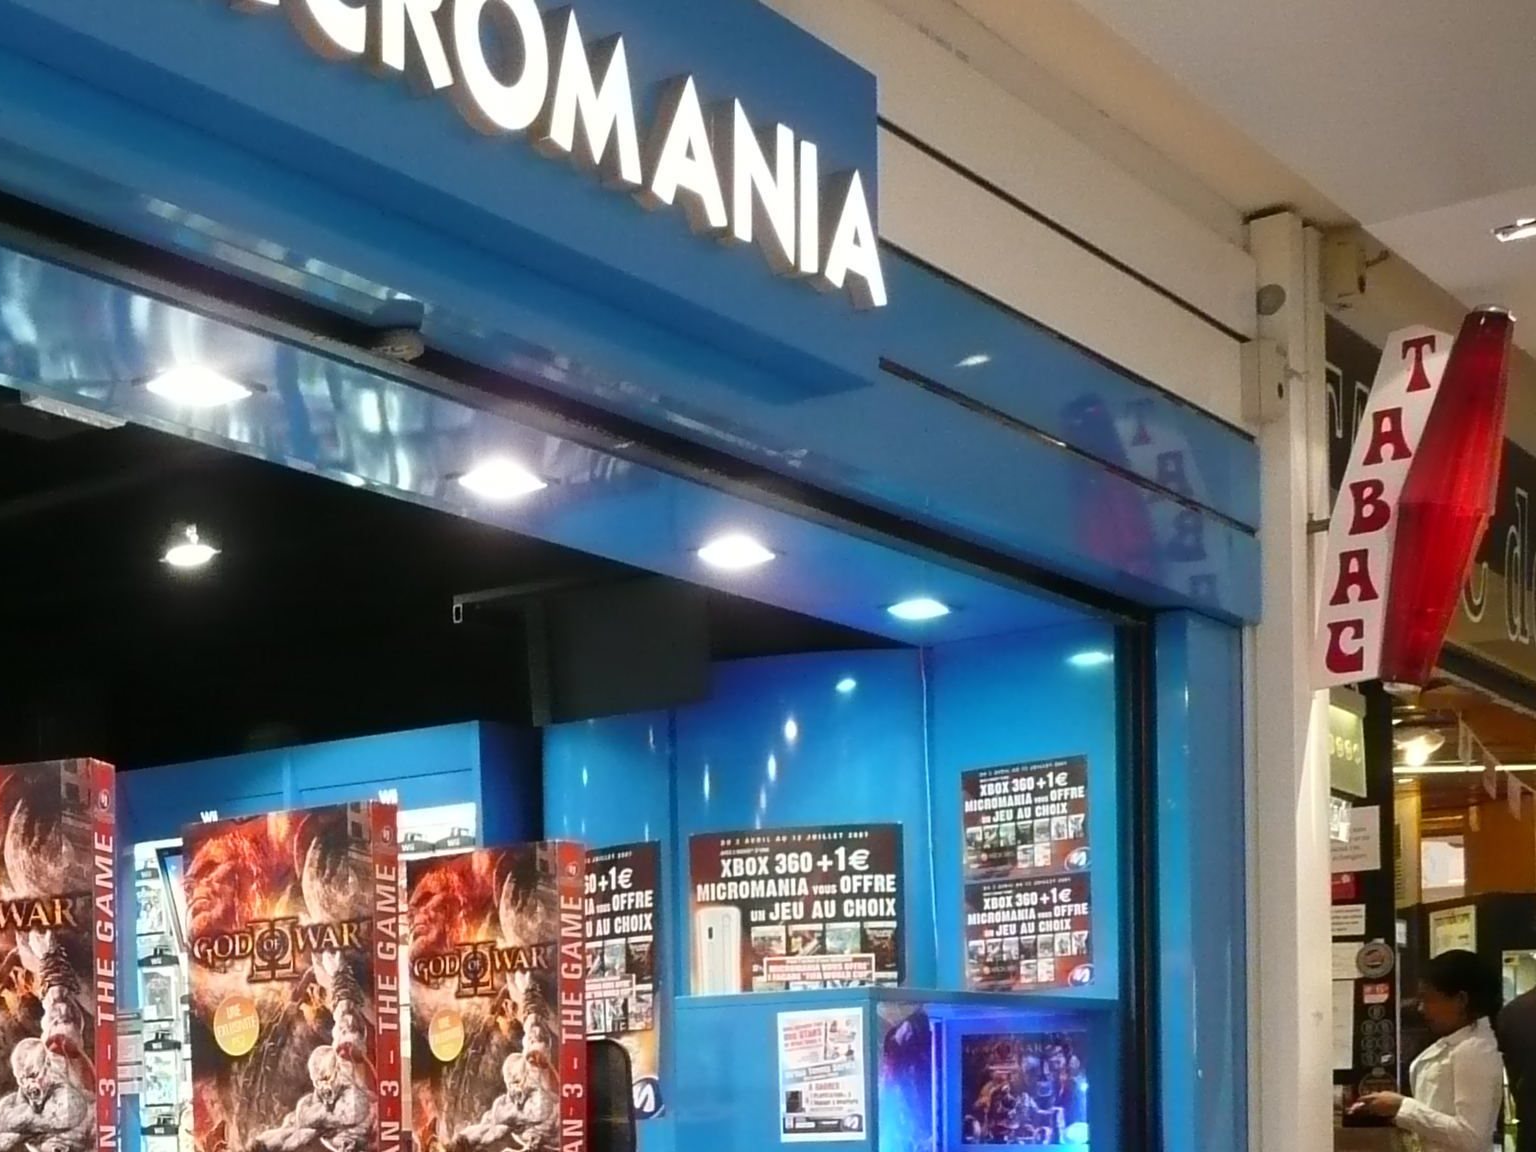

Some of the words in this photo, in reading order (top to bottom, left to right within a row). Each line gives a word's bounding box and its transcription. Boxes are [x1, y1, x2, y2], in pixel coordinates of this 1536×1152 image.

[234, 0, 887, 307] ROMANIA
[1325, 335, 1436, 674] TABAC
[965, 792, 1033, 813] MICROMANIA
[1050, 785, 1085, 802] OFFRE
[980, 781, 1009, 797] XBOX
[1012, 776, 1035, 793] 360
[200, 811, 218, 823] Wii
[992, 808, 1013, 823] JEU
[1017, 806, 1032, 820] AU
[1035, 802, 1068, 818] CHOIX
[720, 856, 769, 878] XBOX
[775, 852, 812, 874] 360
[95, 832, 114, 945] GAME
[612, 890, 653, 911] OFFRE
[696, 878, 809, 902] MICROMANIA
[812, 885, 837, 895] VOUS
[840, 874, 896, 894] OFFRE
[983, 895, 1013, 910] XBOX
[1015, 892, 1038, 907] 360
[376, 864, 397, 961] GAME
[750, 910, 766, 921] UN
[769, 901, 804, 920] JEU
[811, 900, 836, 919] AU
[843, 898, 896, 917] CHOIX
[967, 908, 1036, 925] MICROMANIA
[1053, 902, 1088, 917] OFFRE
[560, 894, 583, 981] GAME
[596, 918, 611, 936] AU
[614, 913, 653, 934] CHOIX
[995, 924, 1016, 936] JEU
[1020, 922, 1035, 934] AU
[1038, 918, 1071, 933] CHOIX
[193, 933, 253, 966] GOD
[263, 937, 280, 952] OF
[294, 923, 362, 950] WAR
[414, 954, 460, 985] GOD
[492, 947, 548, 971] WAR
[97, 960, 115, 1026] THE
[378, 974, 397, 1034] THE
[562, 992, 583, 1045] THE
[99, 1078, 116, 1097] 3
[380, 1080, 399, 1097] 3
[563, 1083, 584, 1099] 3
